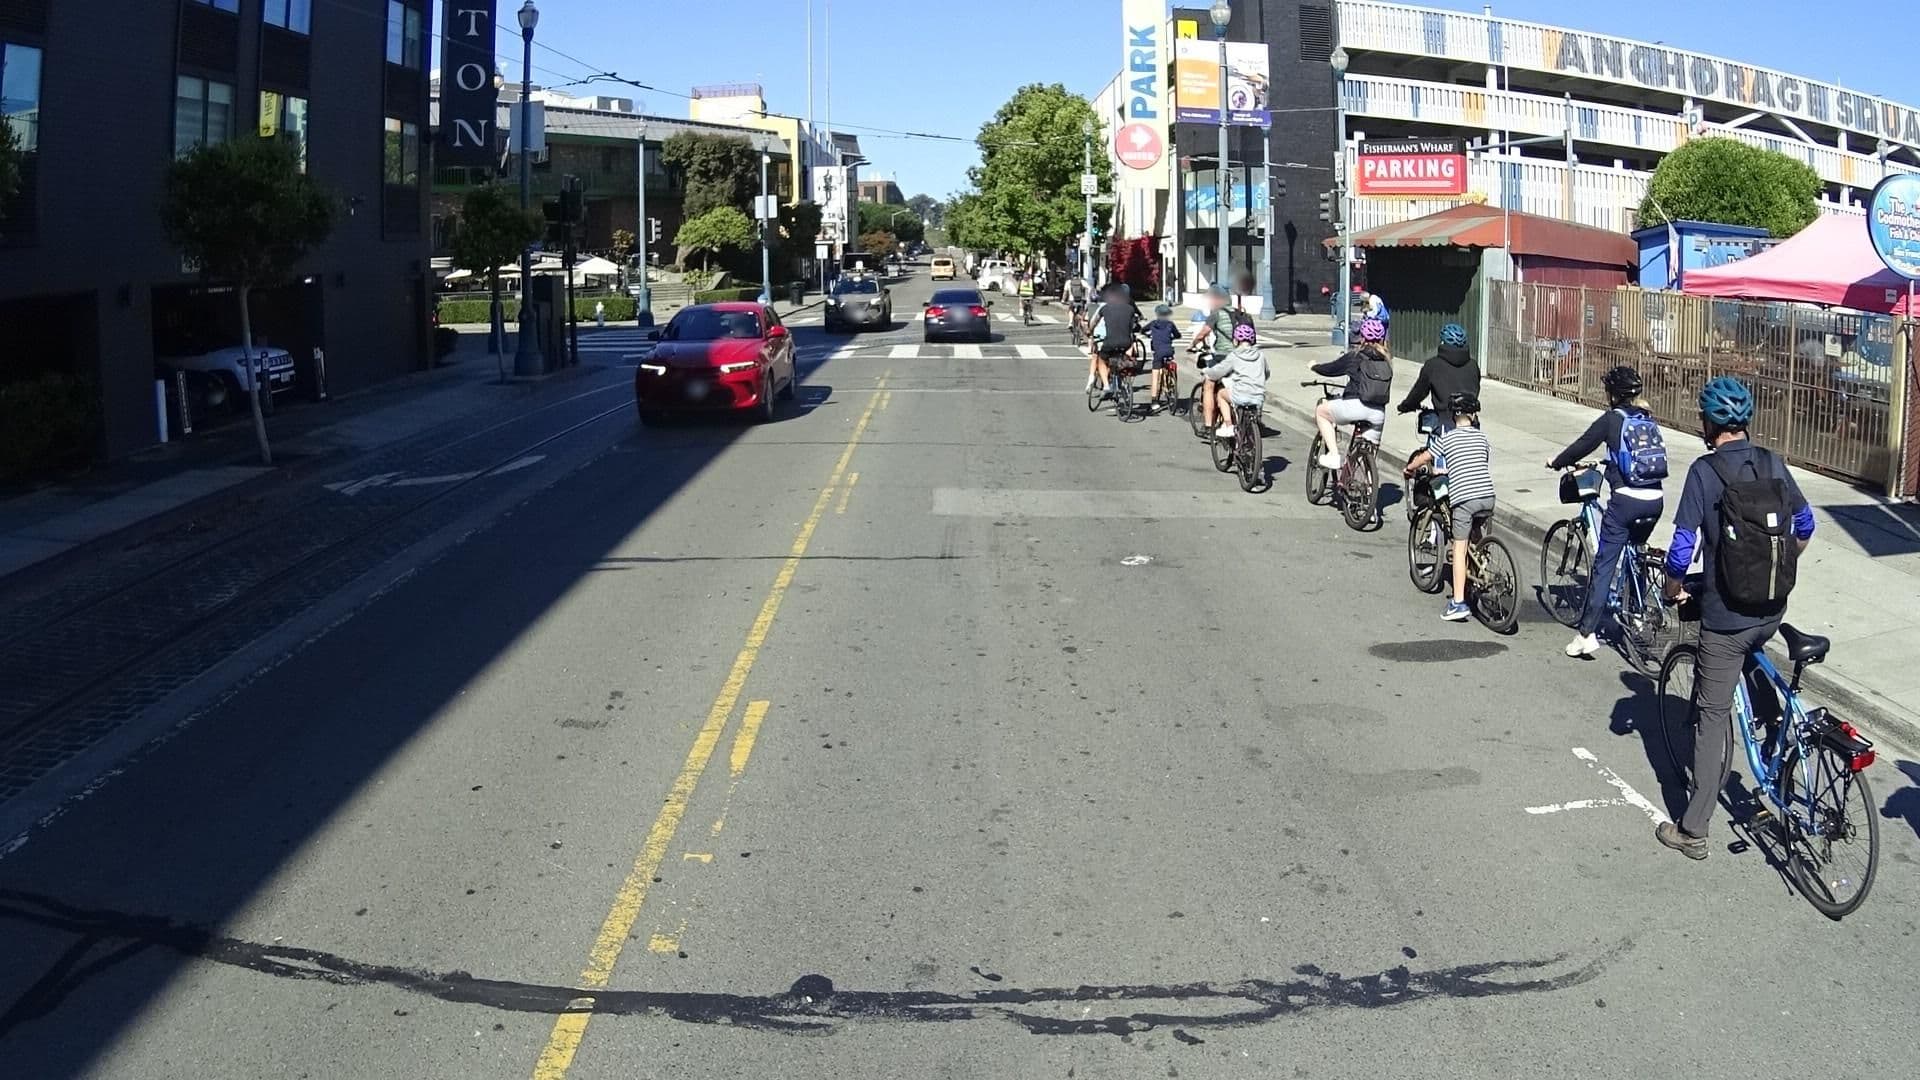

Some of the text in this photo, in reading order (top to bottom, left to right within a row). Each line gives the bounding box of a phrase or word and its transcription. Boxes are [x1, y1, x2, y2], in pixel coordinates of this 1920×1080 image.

[1129, 25, 1157, 119] PARK
[1556, 33, 1831, 121] ANCHORAGE
[1420, 142, 1454, 153] WHARF
[1364, 159, 1455, 178] PARKING
[1083, 184, 1096, 192] 20
[1889, 197, 1906, 214] The
